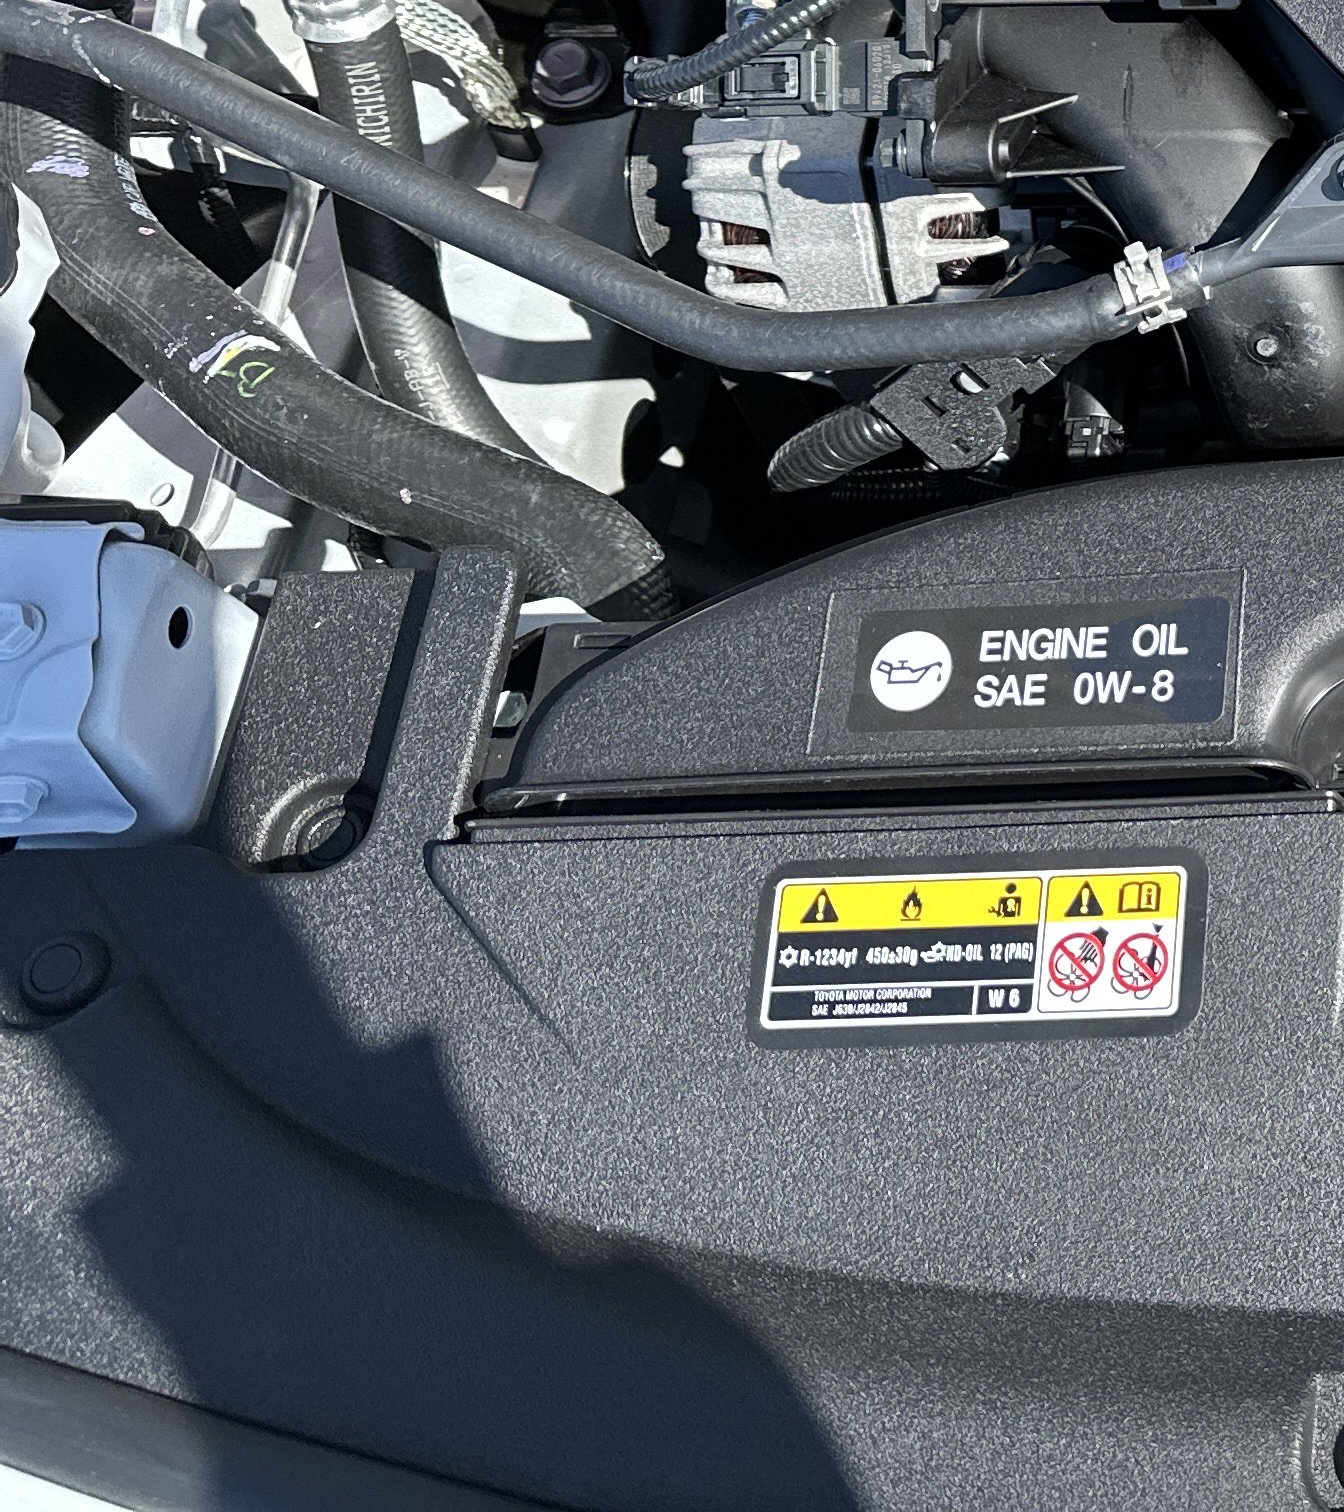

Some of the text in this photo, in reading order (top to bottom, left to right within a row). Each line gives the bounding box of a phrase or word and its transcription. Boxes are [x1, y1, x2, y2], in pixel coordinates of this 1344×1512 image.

[978, 623, 1189, 663] ENGINE OIL
[973, 669, 1175, 709] SAE 0W-8
[799, 947, 858, 968] R-1234yf
[865, 945, 919, 967] 450±30g
[989, 943, 1003, 961] 12
[1004, 941, 1034, 963] (PAG)
[814, 987, 932, 1002] TOYOTA MOTOR CORPORATION
[988, 987, 1021, 1008] W 6
[811, 1003, 829, 1017] SAE
